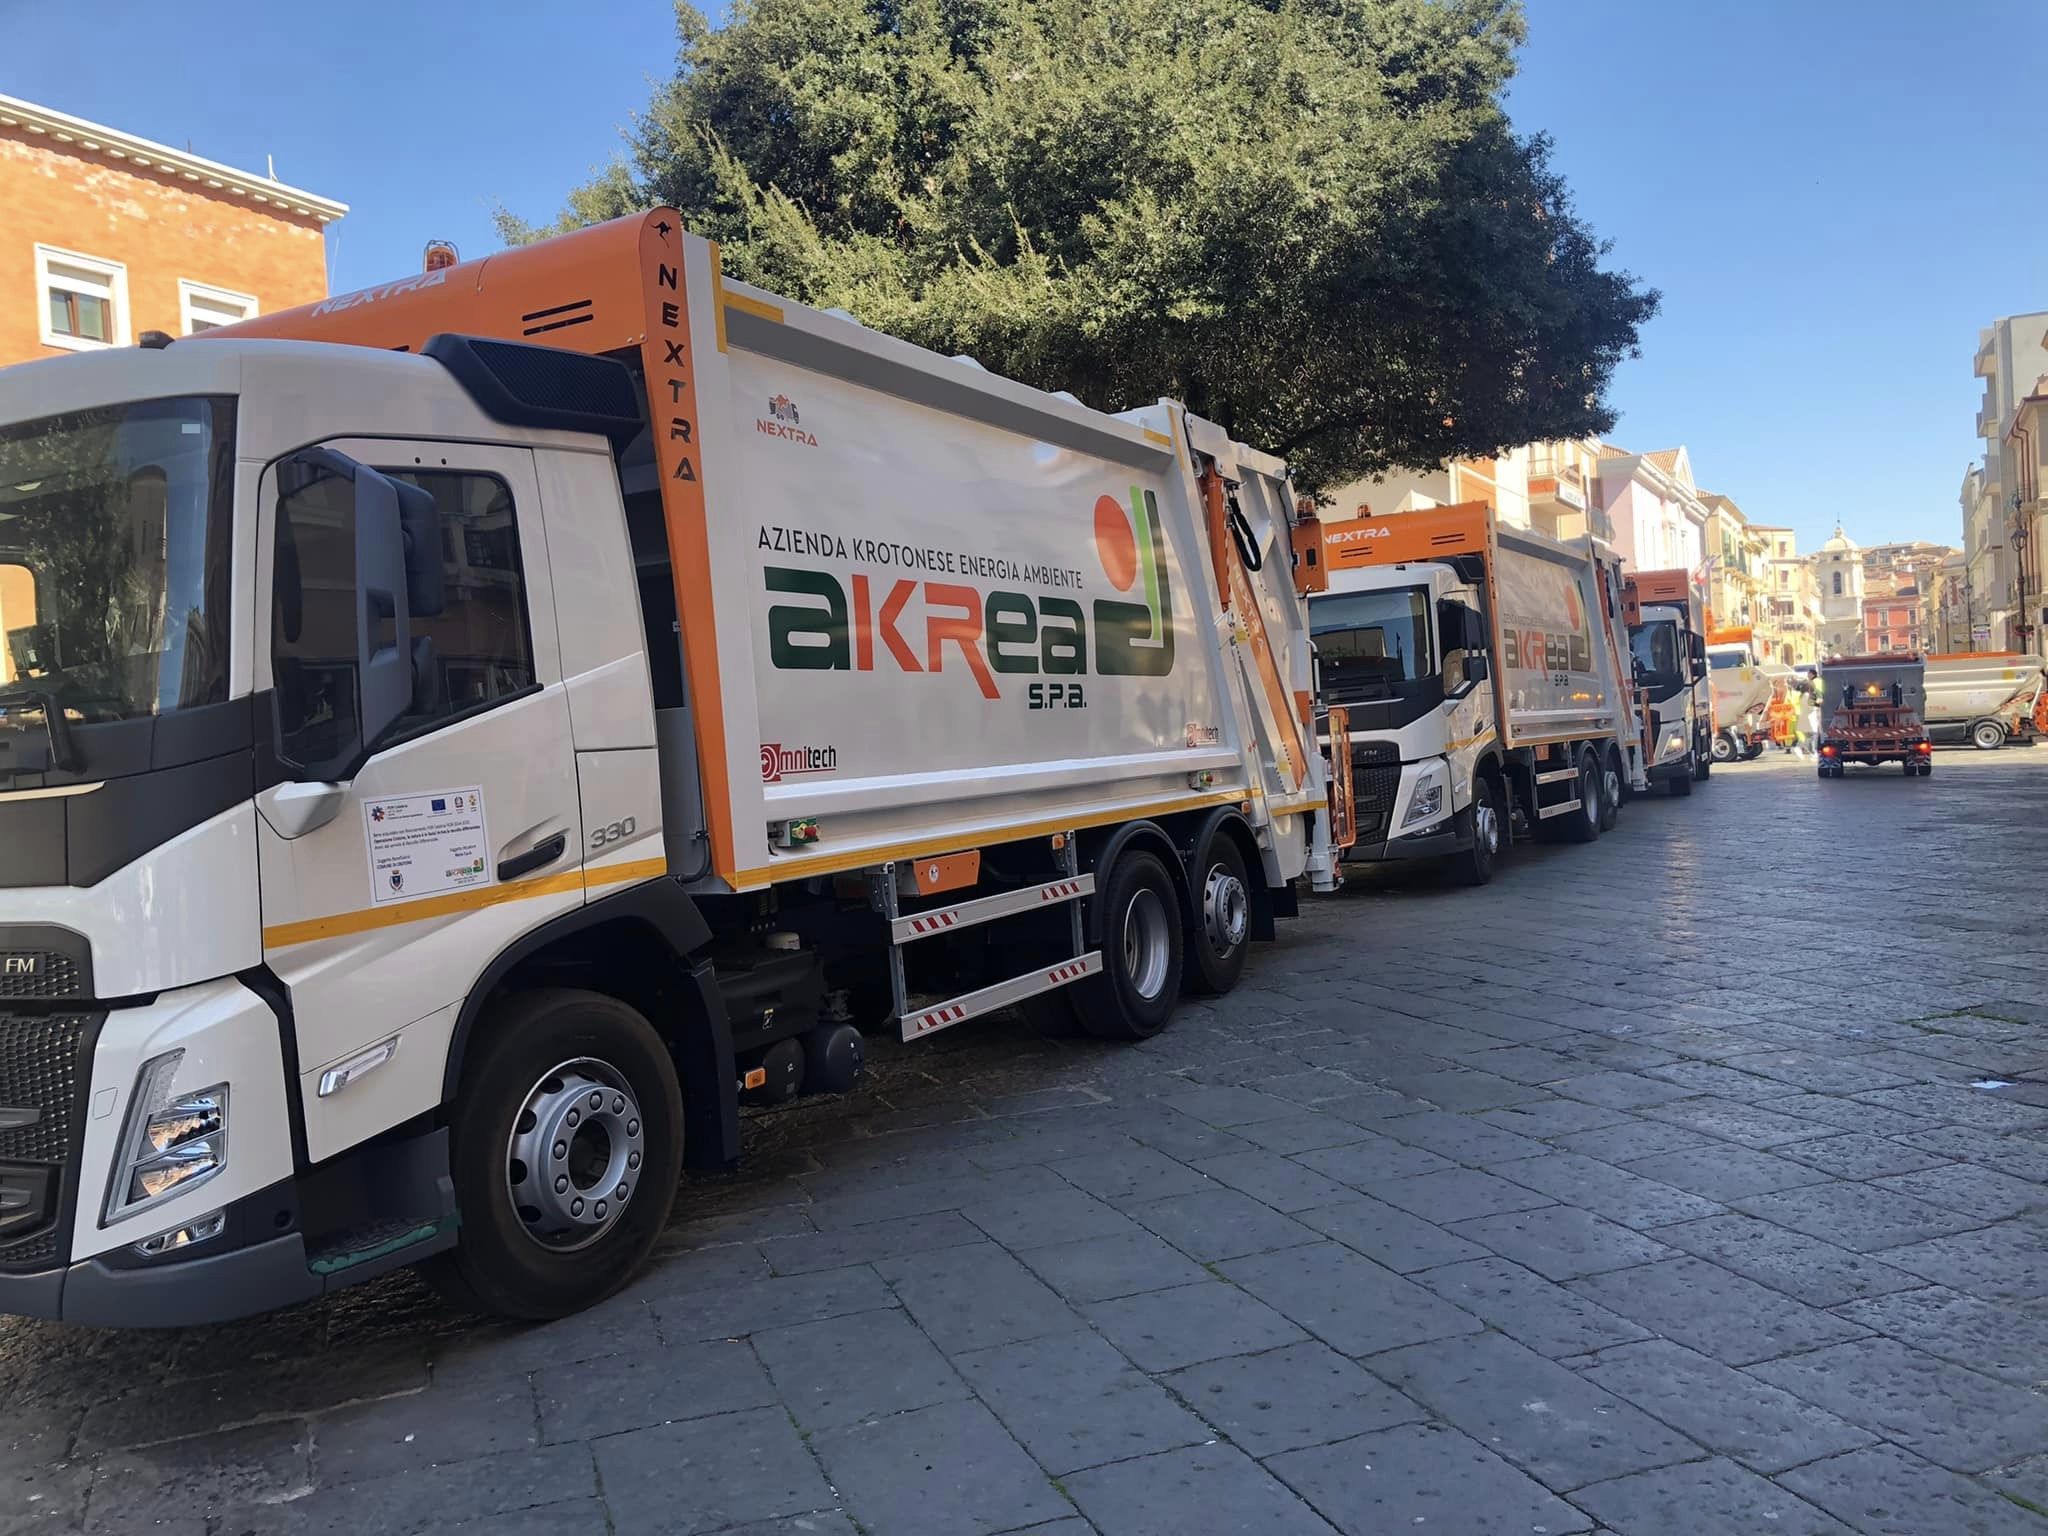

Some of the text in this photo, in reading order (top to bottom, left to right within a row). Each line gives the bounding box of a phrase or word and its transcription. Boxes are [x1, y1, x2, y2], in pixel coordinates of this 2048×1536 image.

[312, 269, 446, 318] NEXTRA
[658, 263, 697, 482] NEXTRA
[756, 418, 818, 447] NEXTRA
[758, 525, 1083, 589] AZIENDA KROTONESE ENERGIA AMBIENTE
[590, 816, 636, 849] 330
[5, 957, 35, 973] FM
